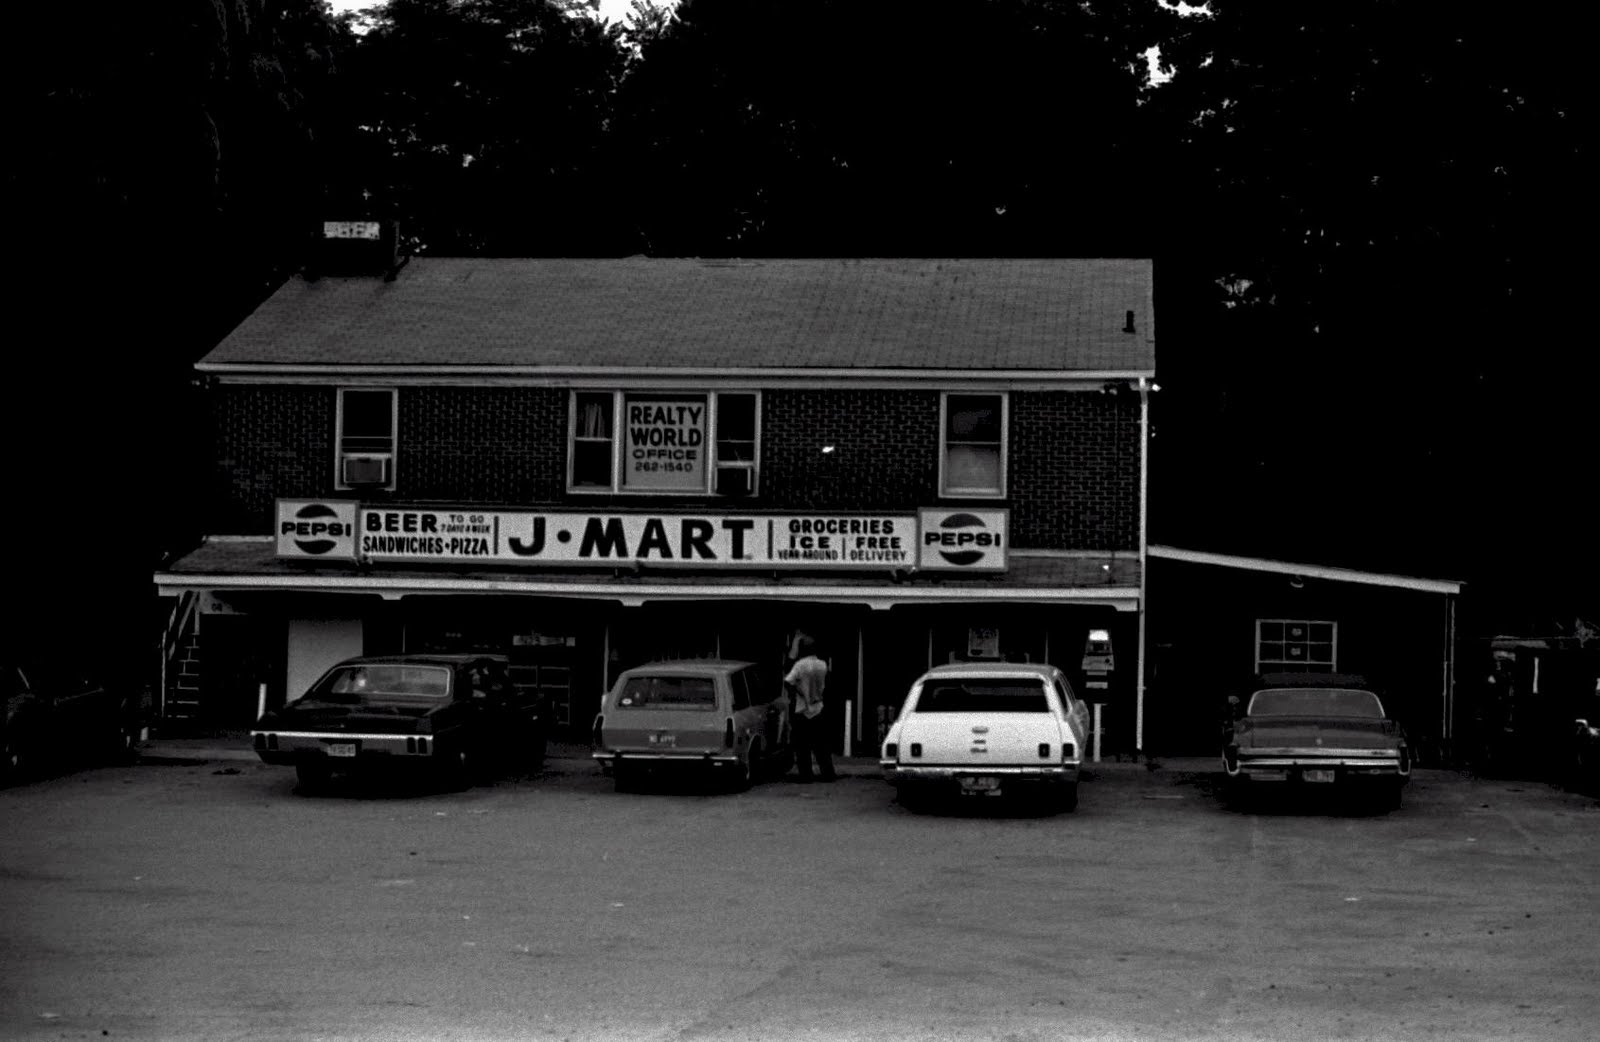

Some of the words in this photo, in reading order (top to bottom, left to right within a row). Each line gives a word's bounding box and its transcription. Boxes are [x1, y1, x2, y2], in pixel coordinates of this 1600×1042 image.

[631, 406, 702, 425] REALTY
[630, 428, 702, 447] WORLD
[633, 449, 697, 460] OFFICE
[366, 513, 438, 532] BEER
[449, 514, 464, 523] TO
[469, 514, 485, 524] GO
[789, 519, 895, 534] GROCERIES
[281, 522, 351, 537] PEPSI
[789, 536, 830, 549] ICE
[856, 536, 902, 549] FREE
[924, 532, 1001, 547] PEPSI
[851, 550, 908, 561] DELIVERY
